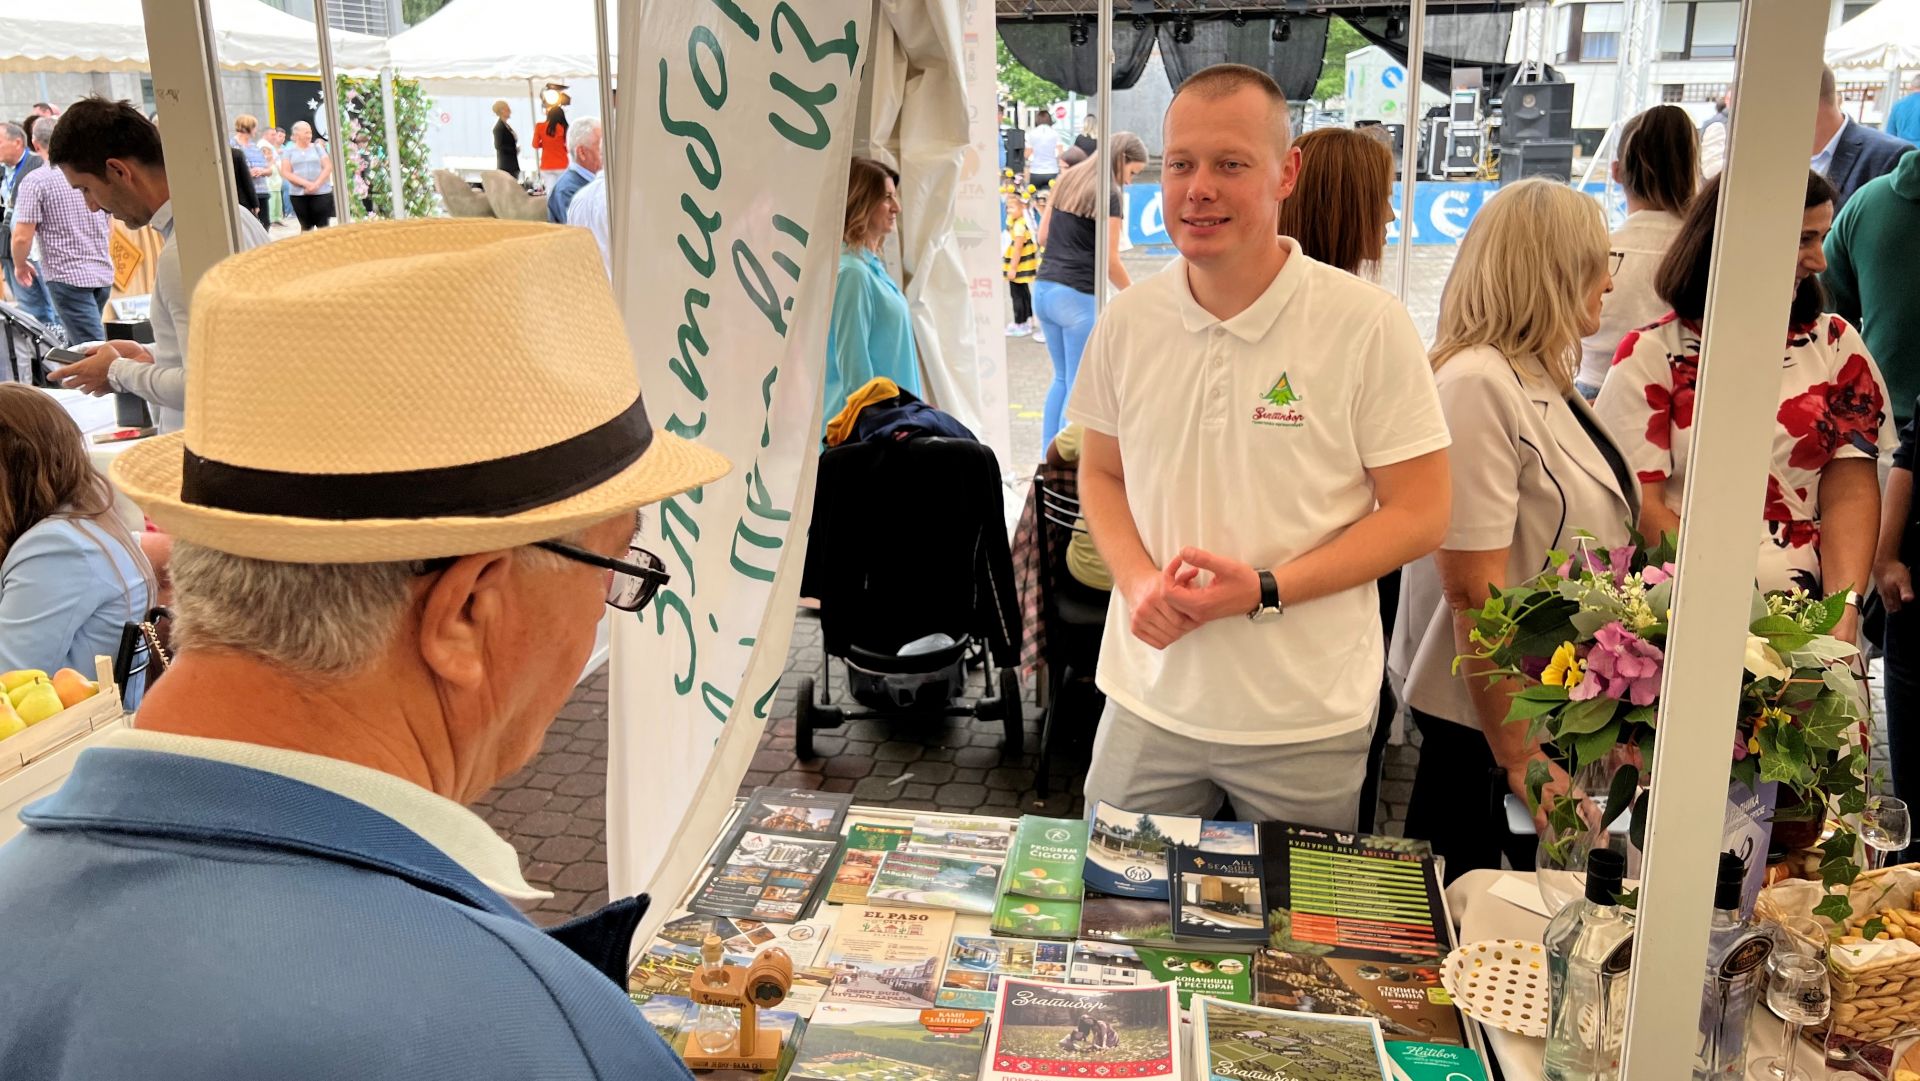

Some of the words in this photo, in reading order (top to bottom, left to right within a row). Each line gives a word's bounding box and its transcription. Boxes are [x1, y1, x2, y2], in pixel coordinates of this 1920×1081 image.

[1030, 844, 1078, 853] PROGRAM
[1337, 846, 1359, 855] ЛЕТО
[1207, 862, 1255, 872] SEASONS
[863, 911, 884, 919] EL
[887, 912, 929, 921] PASO
[1174, 975, 1234, 985] КОНАЧИШТЕ
[1184, 982, 1234, 991] РЕСТОРАН
[1011, 990, 1109, 1013] Златибор
[938, 1011, 966, 1019] КАМП
